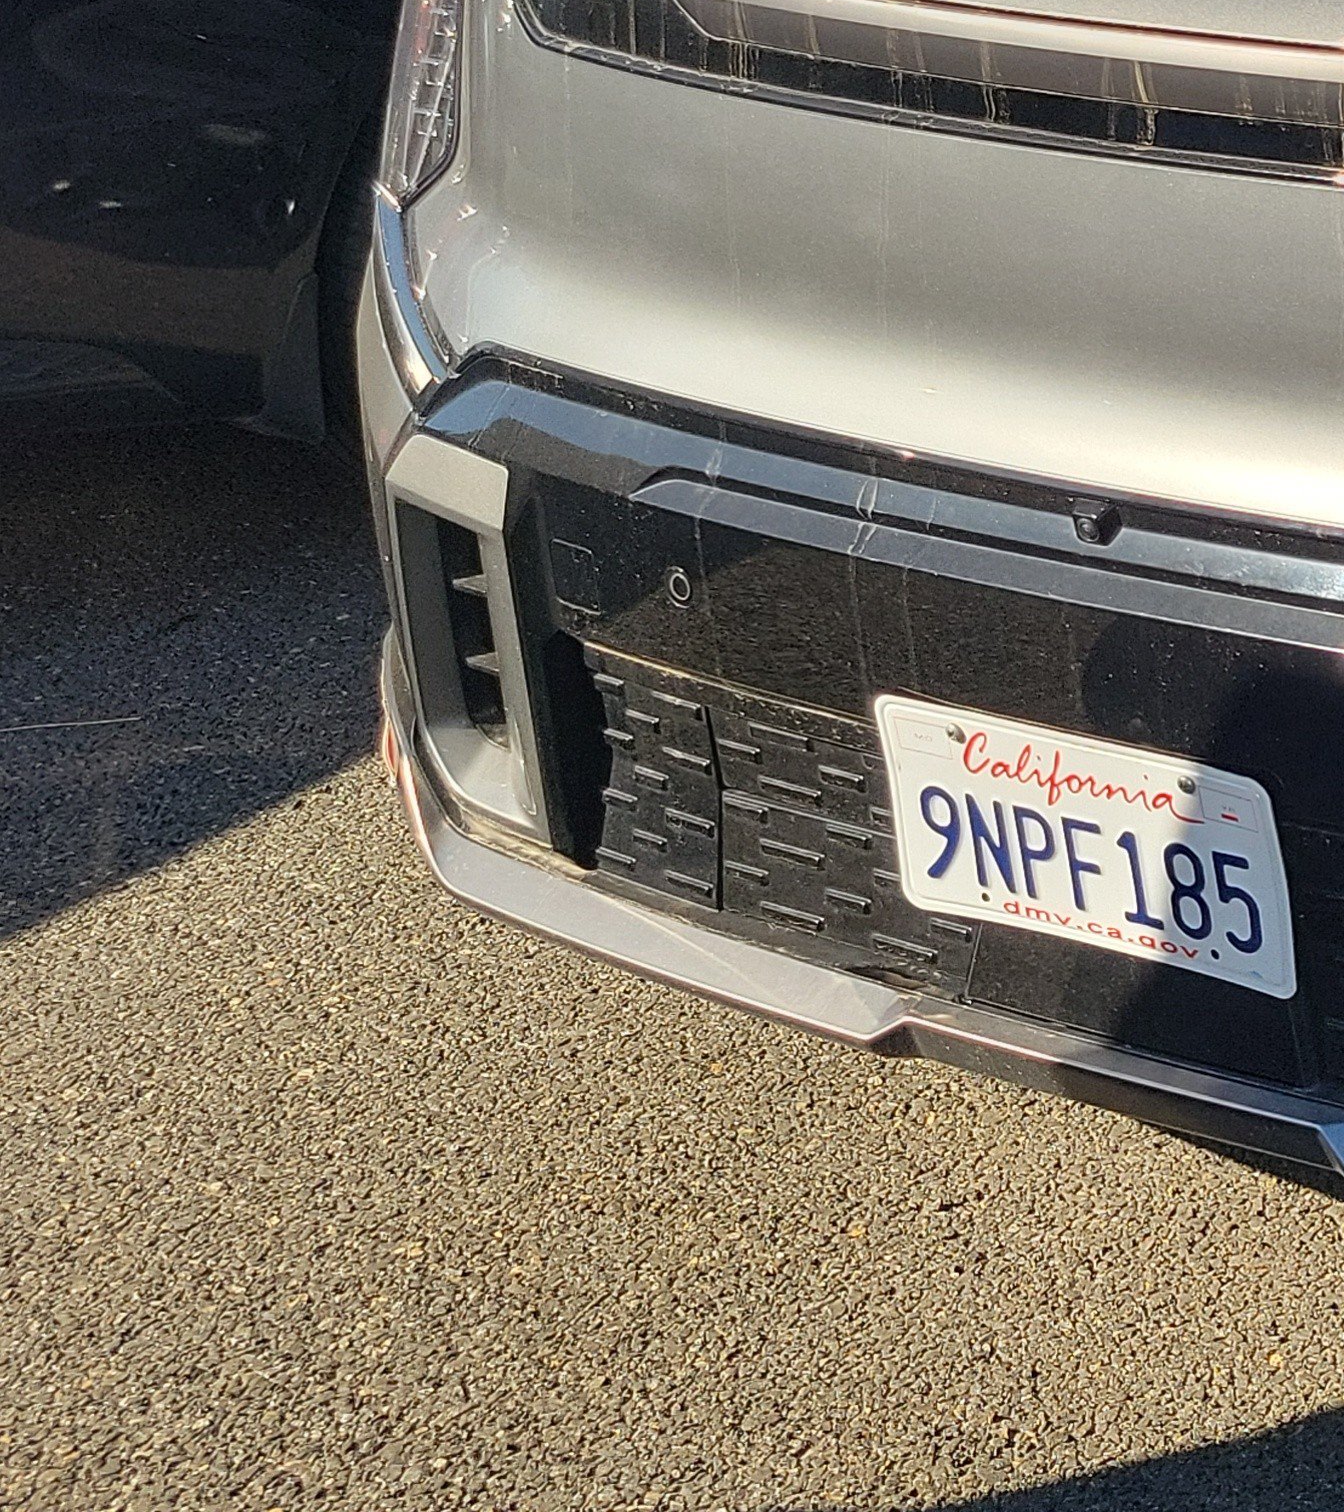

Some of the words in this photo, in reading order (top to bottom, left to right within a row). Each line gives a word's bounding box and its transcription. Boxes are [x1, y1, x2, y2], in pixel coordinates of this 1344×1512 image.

[962, 731, 1204, 825] California
[919, 786, 1264, 955] 9NPF185
[1003, 899, 1200, 960] dmv.ca.gov
